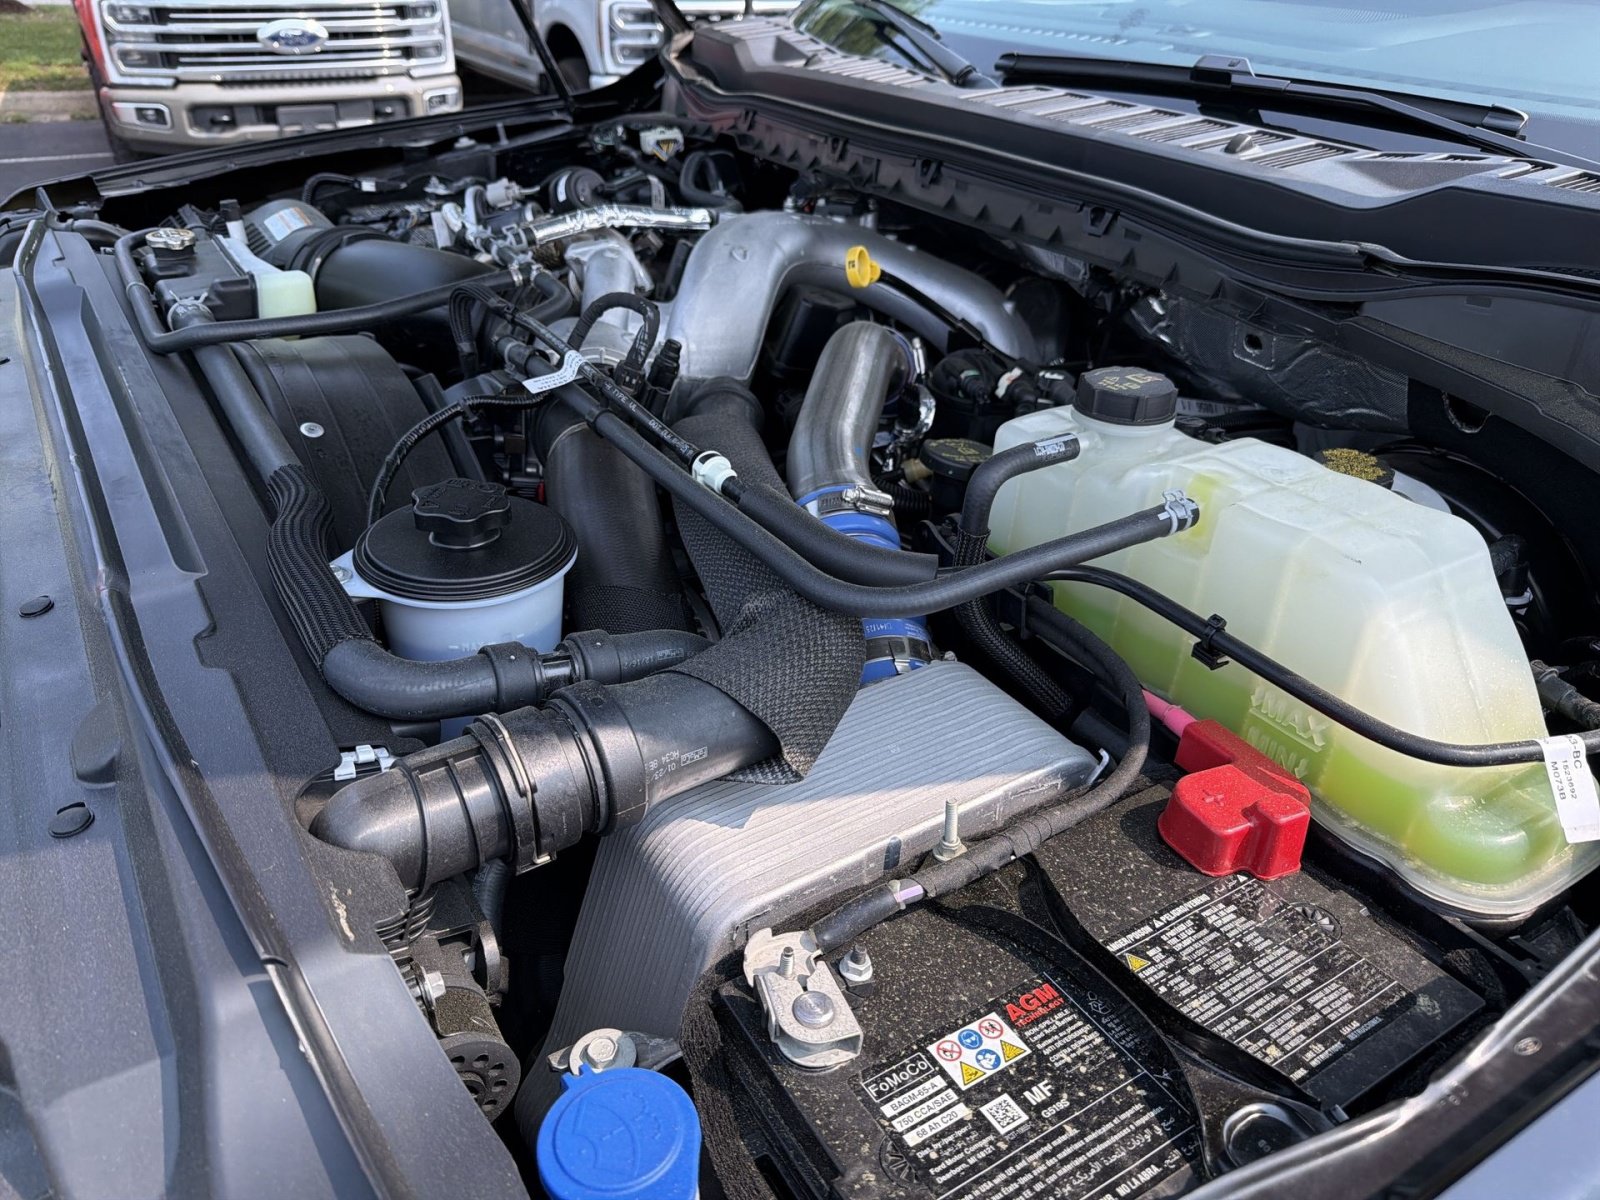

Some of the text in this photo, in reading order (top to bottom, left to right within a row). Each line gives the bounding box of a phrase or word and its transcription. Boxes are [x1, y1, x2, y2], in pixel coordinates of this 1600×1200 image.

[1260, 689, 1333, 747] MAX
[1550, 759, 1567, 802] M073B
[1107, 894, 1210, 952] ANGER/POISON PELIGRO/VENENO
[1006, 984, 1058, 1020] AGM
[1015, 998, 1064, 1027] TECHNOLOGY
[1024, 1009, 1070, 1037] NON-SPILLABLE
[1029, 1014, 1078, 1043] Lead Acid Battery
[1036, 1035, 1060, 1050] Batterie
[1066, 1021, 1084, 1034] plomb
[1340, 1020, 1360, 1035] LEA LAS
[1042, 1045, 1056, 1056] ANTI
[1053, 1024, 1092, 1048] DÉVERSEMENT
[1049, 1047, 1072, 1062] CONTRA
[1070, 1031, 1100, 1050] DERRAMES
[868, 1061, 928, 1096] FoMoCo
[1024, 1079, 1053, 1105] MF
[890, 1082, 938, 1111] BAGM-65-A
[897, 1092, 954, 1128] 750 CCA/SAE
[1041, 1096, 1070, 1118] G519S
[916, 1110, 958, 1138] 68 Ah C20
[916, 1147, 934, 1158] Dist.
[1127, 1128, 1152, 1150] الولايات
[929, 1162, 947, 1175] Ford
[944, 1152, 965, 1166] Motor
[967, 1156, 978, 1165] MI
[976, 1145, 995, 1159] 48121
[978, 1181, 994, 1192] USA
[992, 1173, 1008, 1184] with
[1004, 1166, 1016, 1176] US
[1015, 1159, 1028, 1170] and
[1027, 1144, 1053, 1165] imported
[1001, 1173, 1034, 1195] États-Unis
[1032, 1164, 1047, 1176] avec
[1045, 1157, 1058, 1167] des
[1056, 1140, 1086, 1160] matériaux
[1112, 1117, 1121, 1125] et
[1100, 1144, 1127, 1166] المتحدة
[1022, 1189, 1036, 1199] EE.
[1033, 1181, 1047, 1192] UU.
[1045, 1174, 1058, 1184] con
[1056, 1155, 1088, 1176] materiales
[1116, 1165, 1162, 1196] NO LA ABRA.
